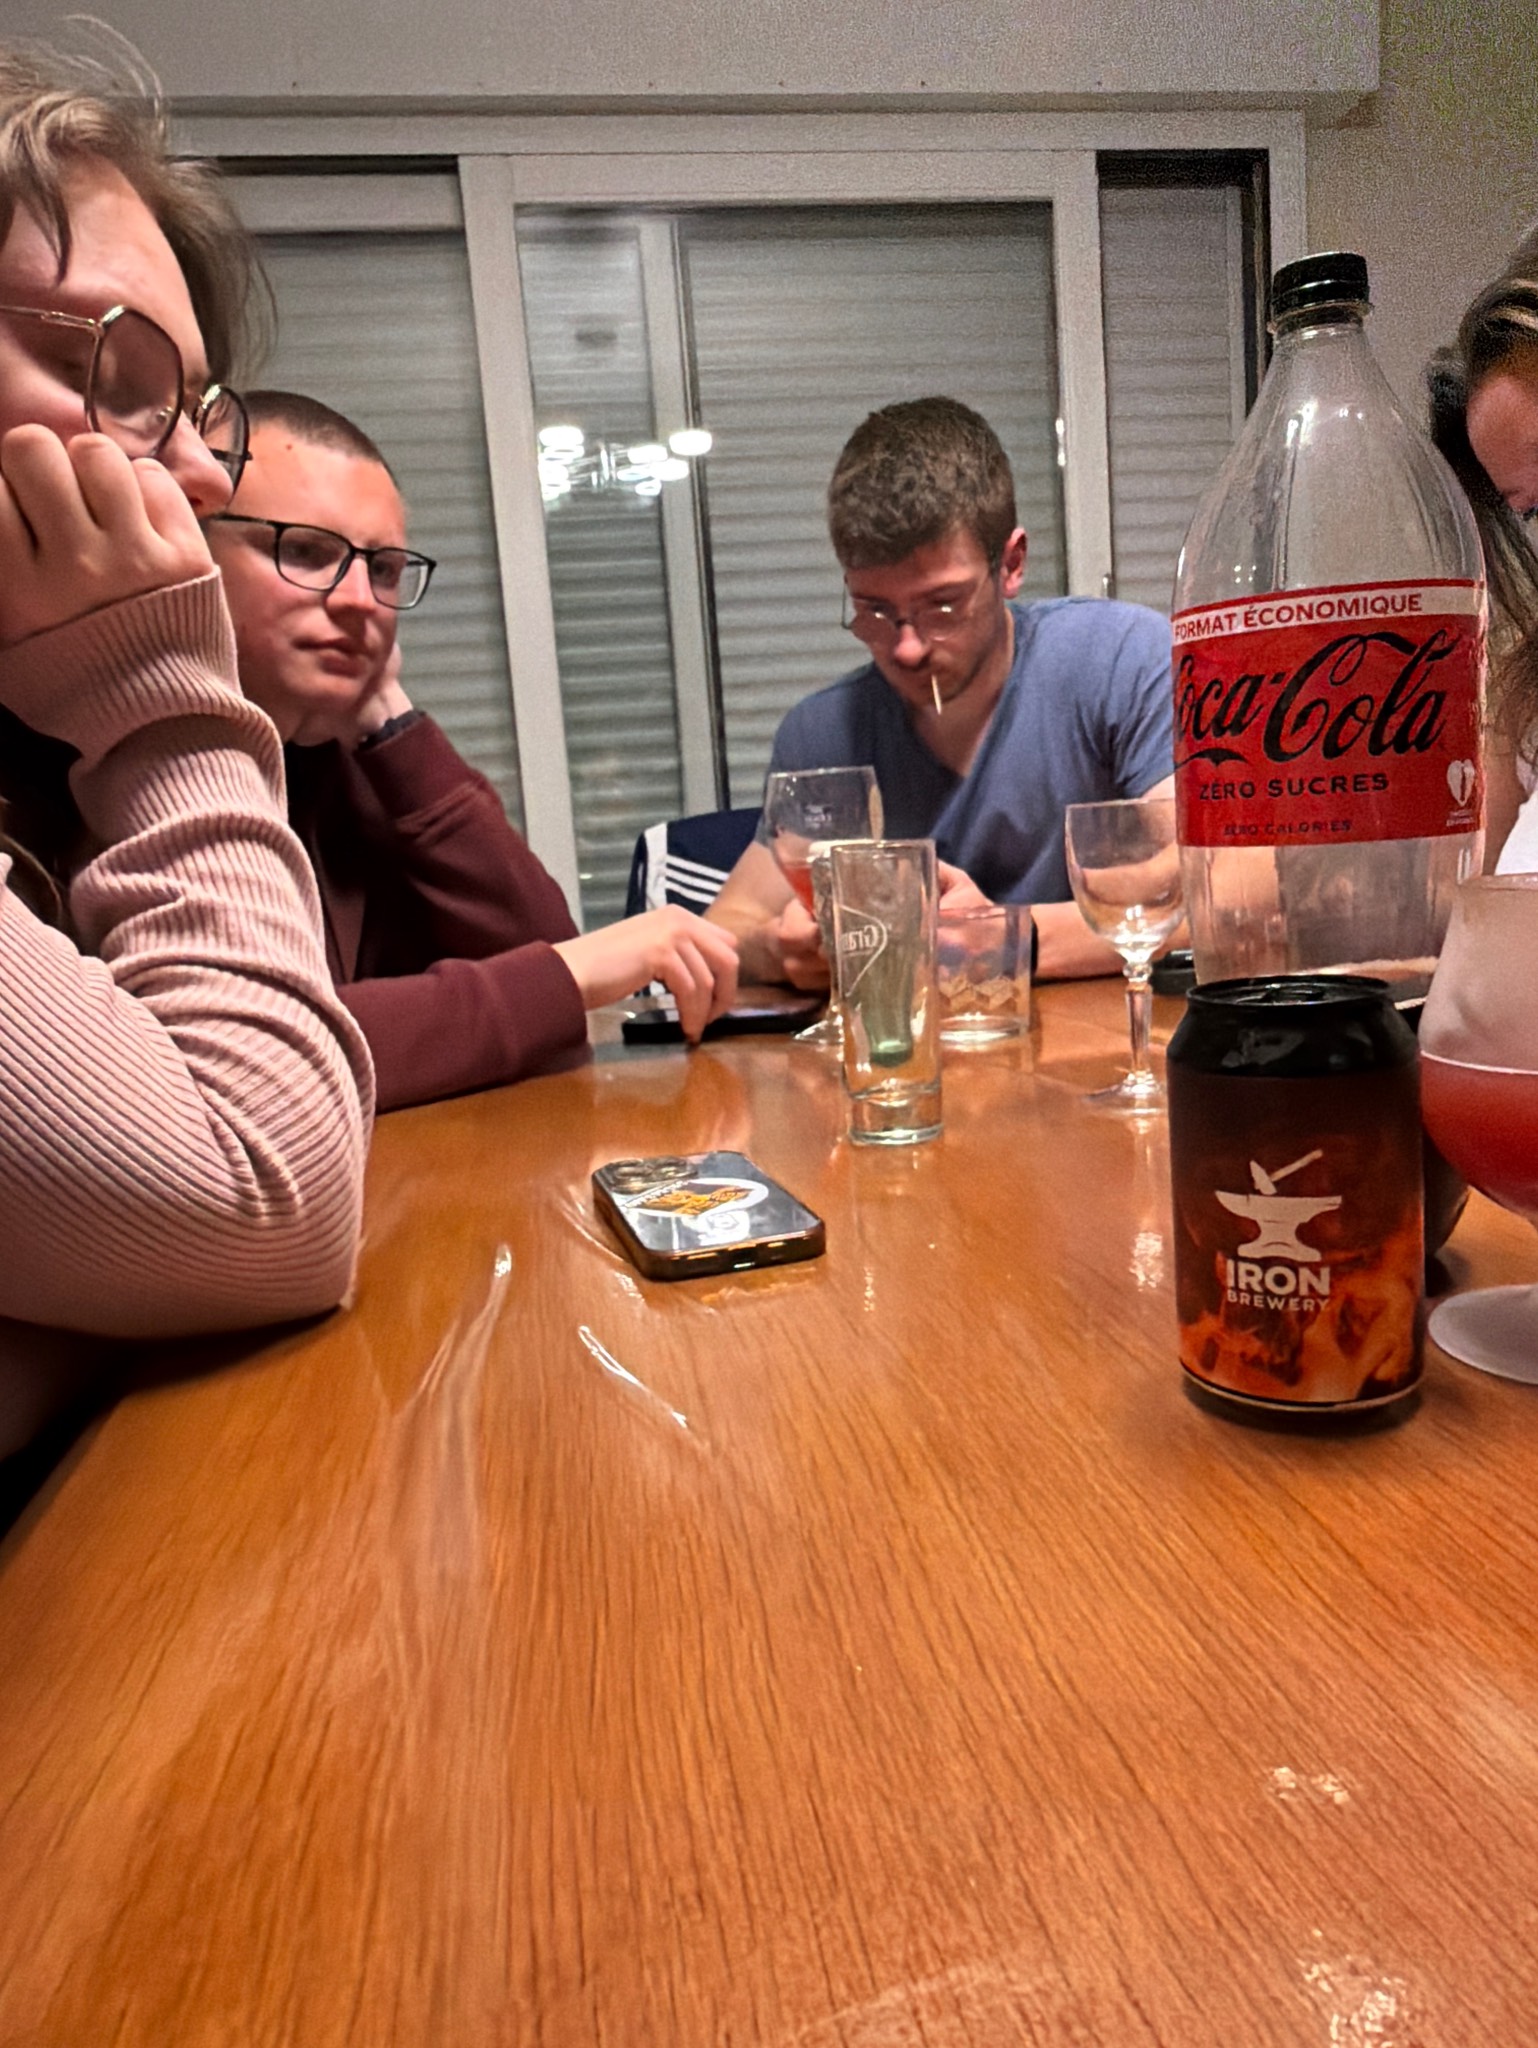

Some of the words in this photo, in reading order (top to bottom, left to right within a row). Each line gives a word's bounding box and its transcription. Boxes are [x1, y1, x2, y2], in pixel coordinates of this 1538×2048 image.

[1174, 612, 1236, 638] FORMAT
[1244, 593, 1423, 628] ÉCONOMIQUE
[1268, 773, 1390, 798] SUCRES
[1227, 1259, 1331, 1295] IRON
[1227, 1291, 1330, 1312] BREWERY
